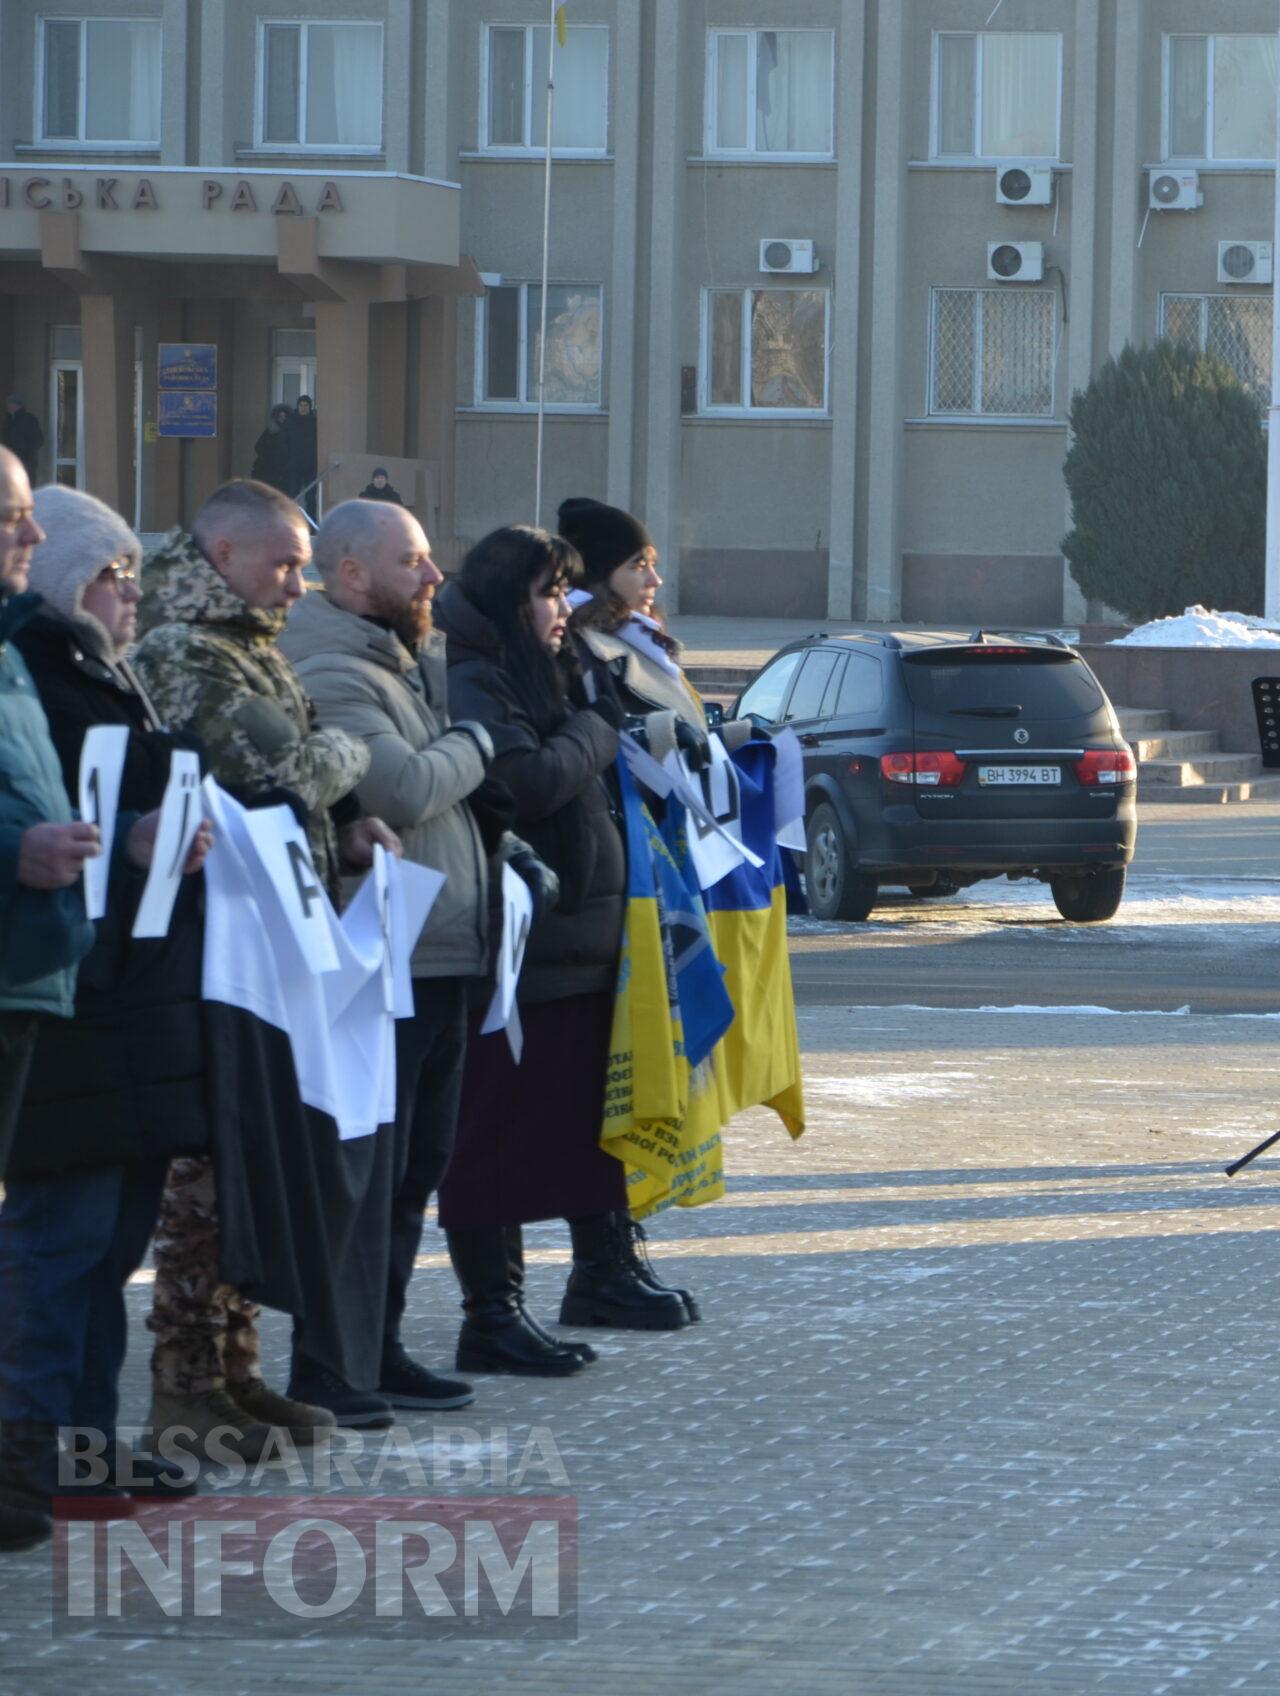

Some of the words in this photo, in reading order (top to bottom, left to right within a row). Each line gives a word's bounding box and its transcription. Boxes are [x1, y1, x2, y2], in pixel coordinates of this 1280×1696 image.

[202, 180, 344, 216] РАДА
[986, 768, 1006, 782] BH
[1007, 768, 1037, 782] 3994
[1041, 768, 1059, 782] BT
